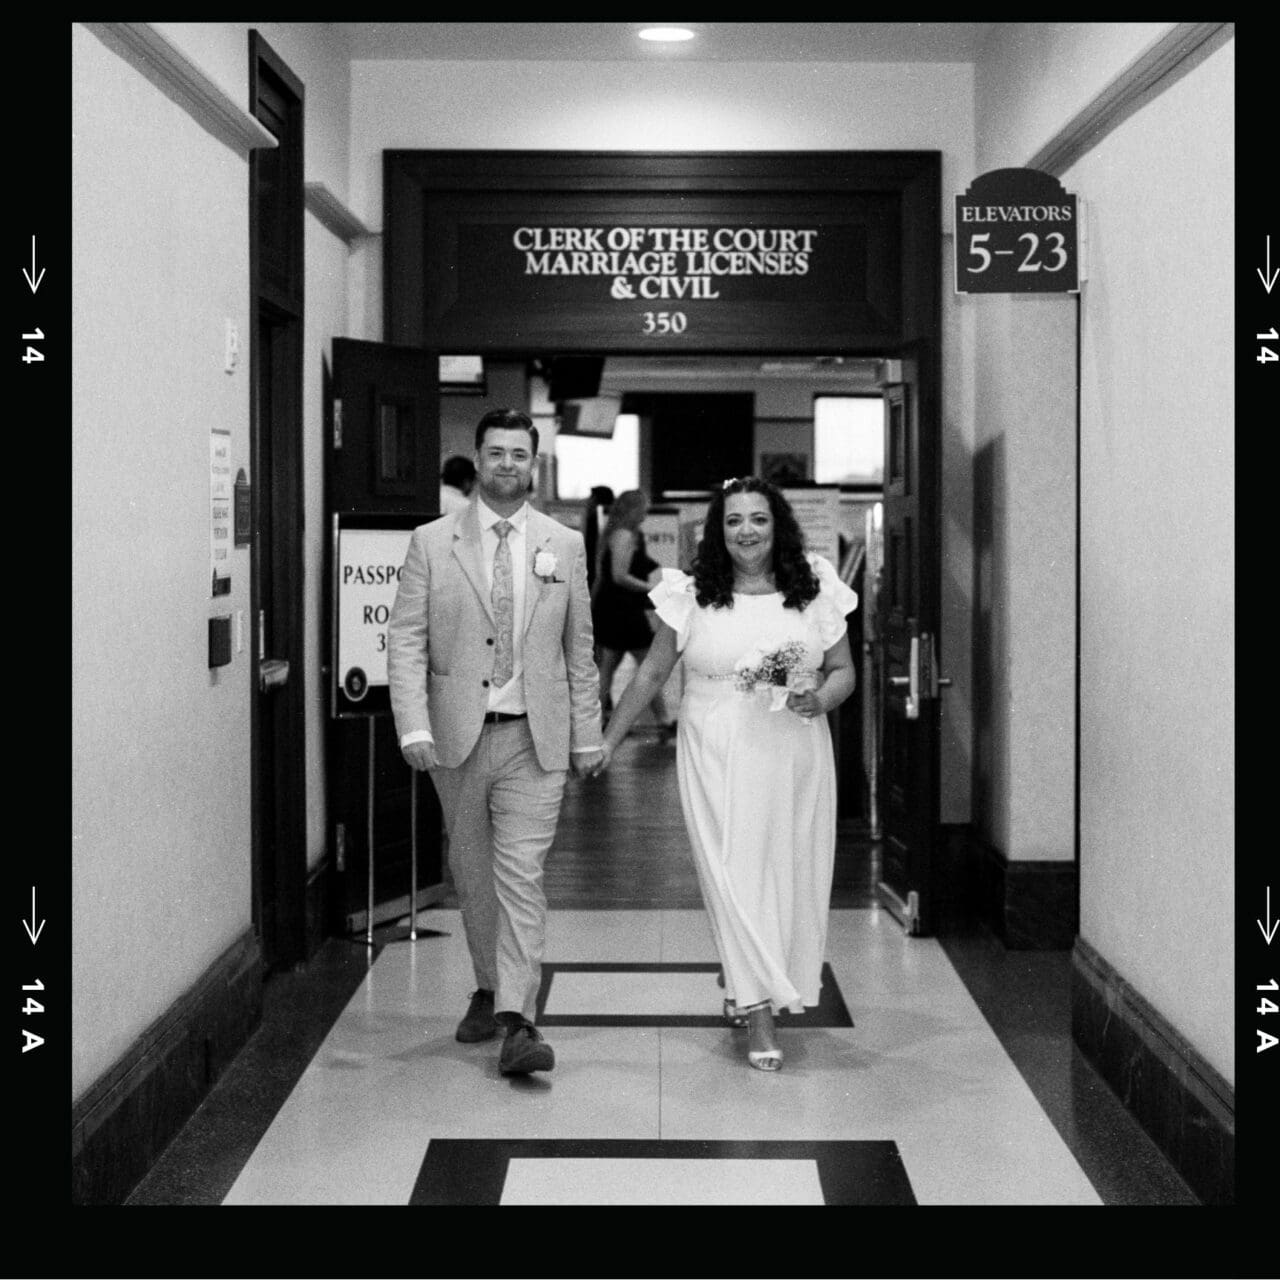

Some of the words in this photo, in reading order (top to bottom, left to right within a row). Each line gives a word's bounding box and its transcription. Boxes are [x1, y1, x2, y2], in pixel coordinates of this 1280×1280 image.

[962, 205, 1072, 222] ELEVATORS
[513, 227, 605, 252] CLERK
[607, 227, 645, 252] OF
[647, 228, 709, 252] THE
[713, 228, 817, 253] COURT
[525, 251, 678, 275] MARRIAGE
[686, 251, 809, 275] LICENSES
[610, 276, 637, 300] &
[639, 276, 720, 299] CIVIL
[642, 312, 688, 333] 350
[363, 604, 389, 625] RO
